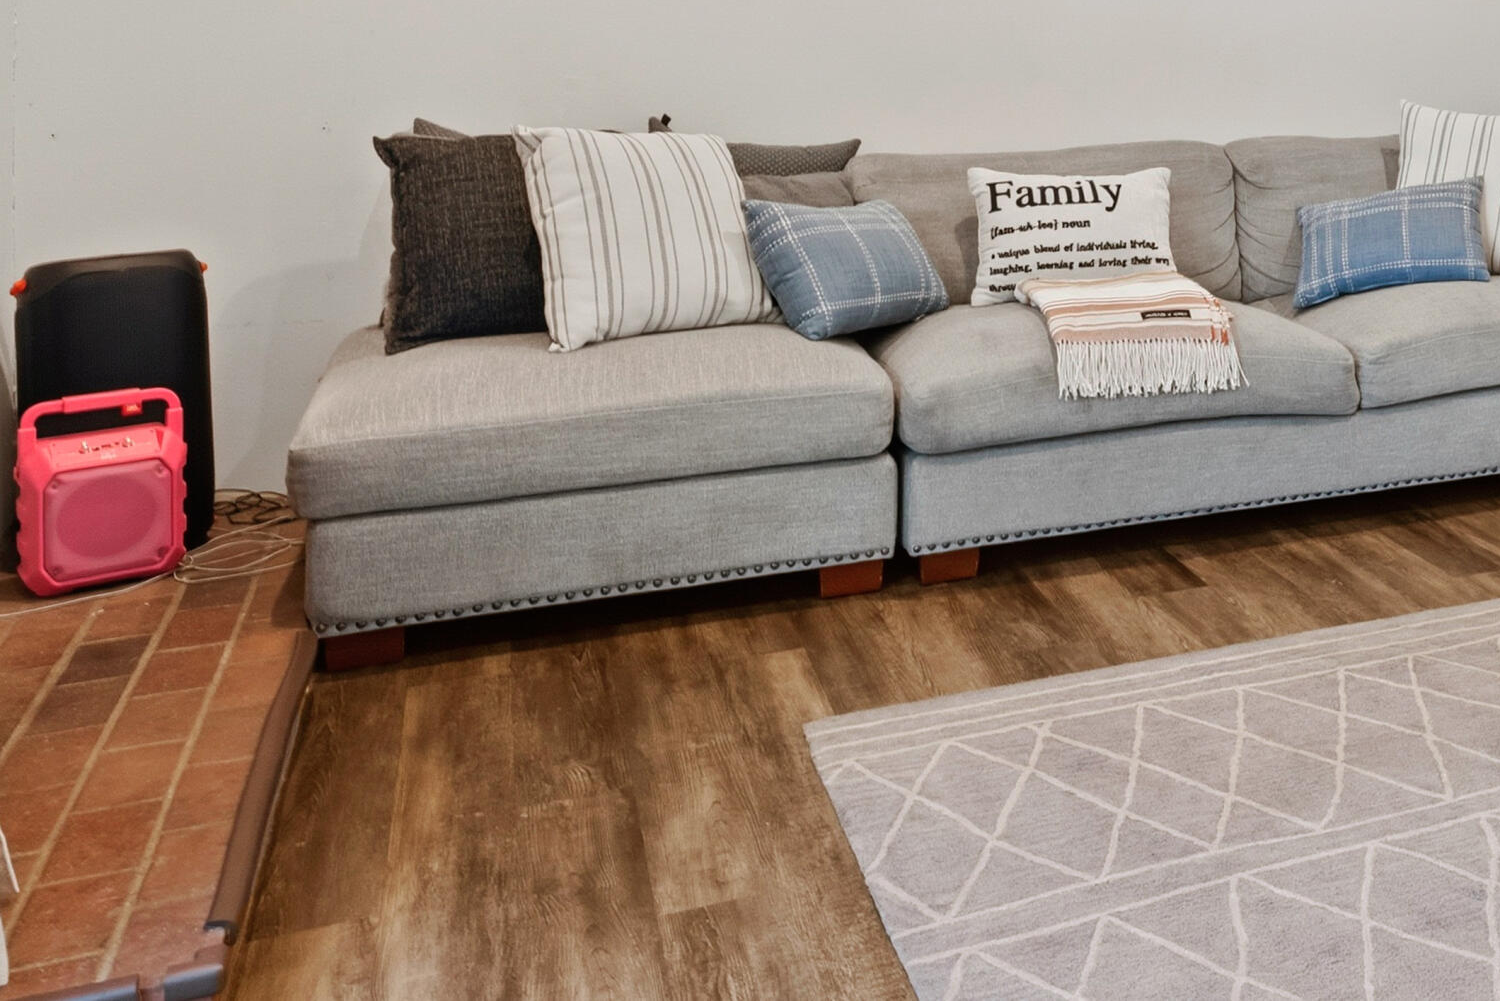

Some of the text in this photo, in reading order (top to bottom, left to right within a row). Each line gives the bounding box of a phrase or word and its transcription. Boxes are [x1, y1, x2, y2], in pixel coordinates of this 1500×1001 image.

[986, 180, 1121, 213] Family
[1062, 220, 1091, 229] noun
[997, 248, 1030, 259] unique
[1033, 244, 1060, 254] blend
[1064, 243, 1073, 252] of
[1076, 241, 1127, 252] individuals
[1036, 259, 1074, 270] learning
[1079, 259, 1095, 268] and
[1098, 257, 1127, 268] loving
[1130, 256, 1152, 265] their
